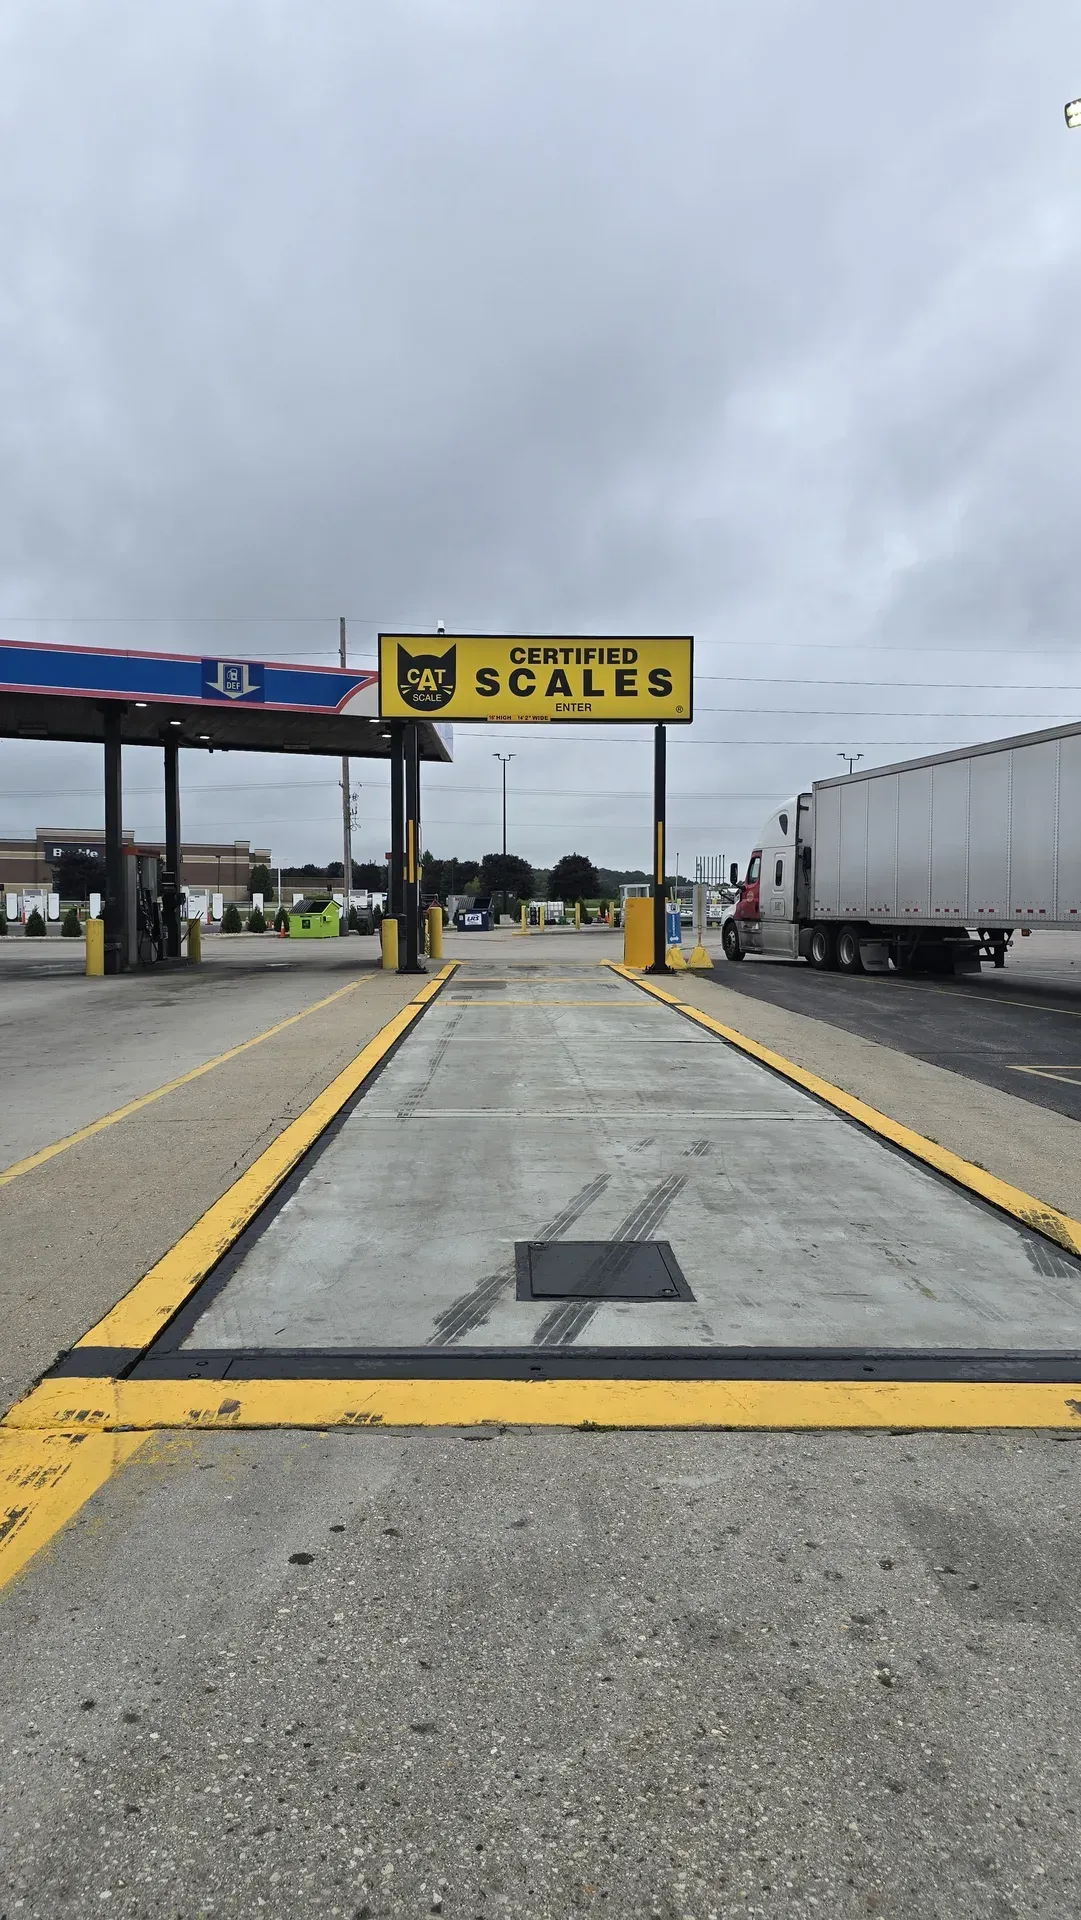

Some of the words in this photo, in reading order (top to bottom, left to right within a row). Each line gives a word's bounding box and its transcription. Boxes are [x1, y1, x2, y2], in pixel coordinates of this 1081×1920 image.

[510, 647, 638, 665] CERTIFIED
[226, 681, 241, 690] DEF
[407, 668, 446, 691] CAT
[475, 667, 673, 697] SCALES
[412, 693, 442, 702] SCALE
[555, 703, 592, 712] ENTER
